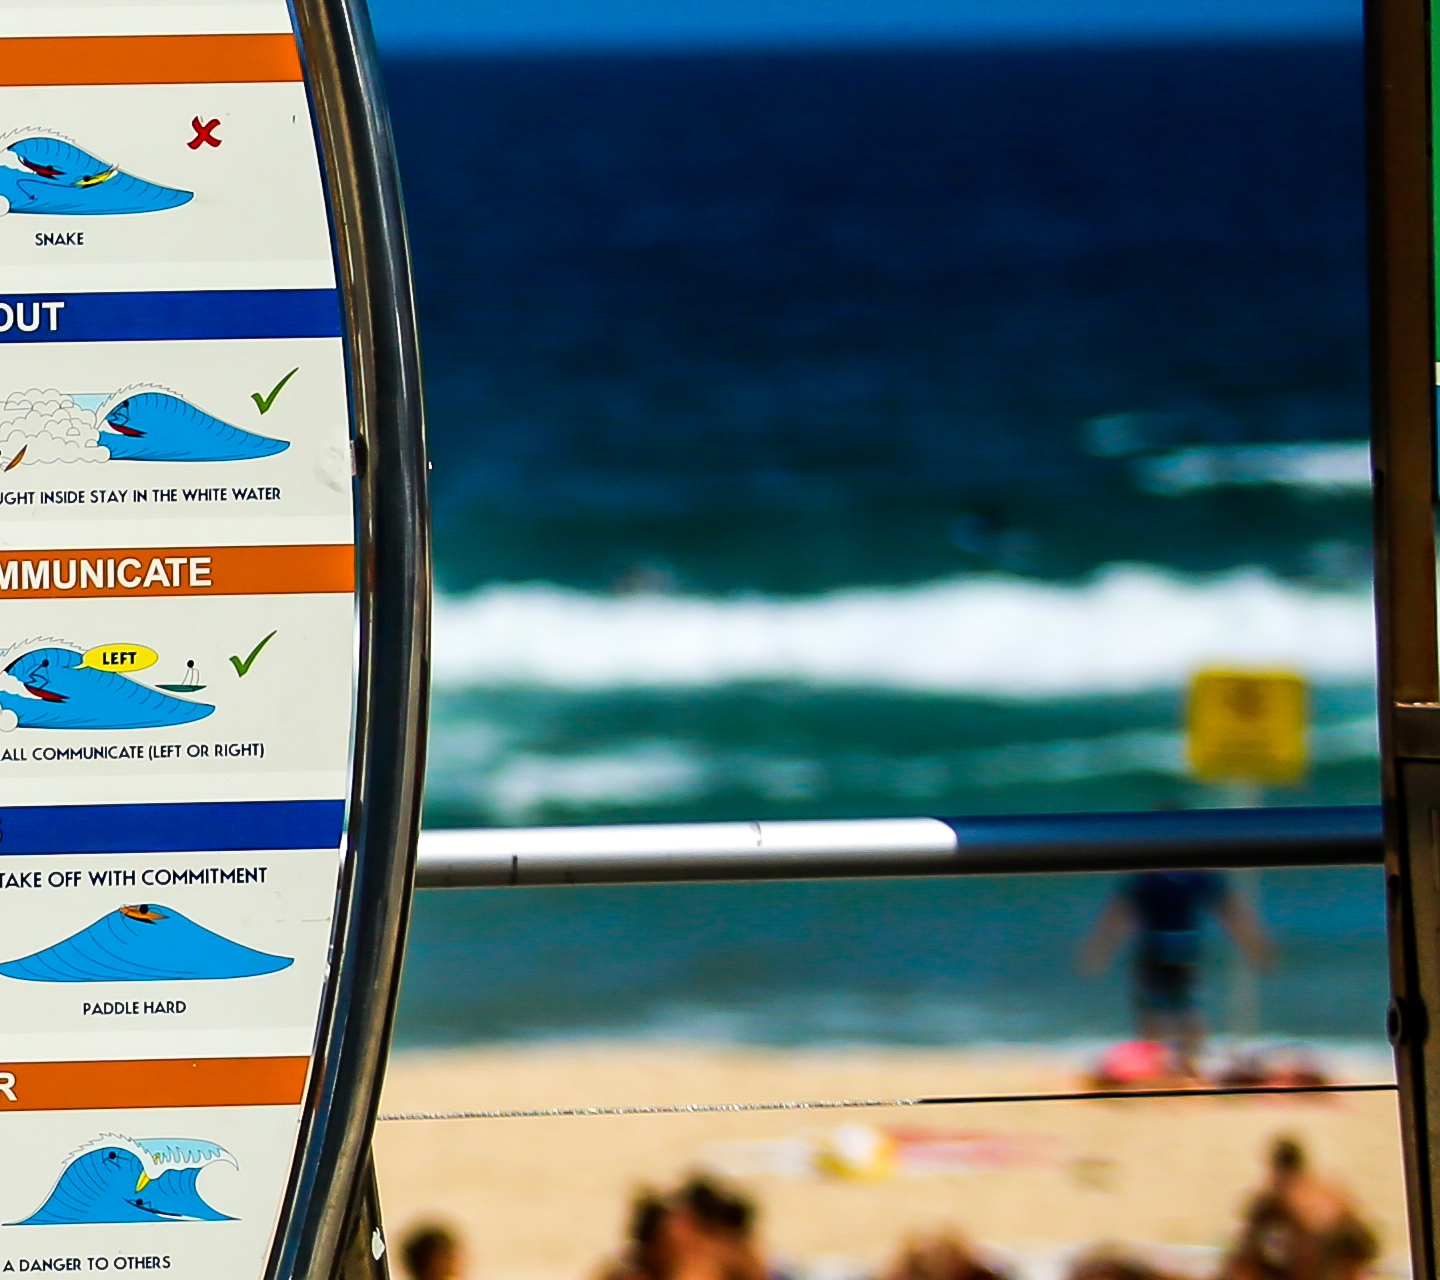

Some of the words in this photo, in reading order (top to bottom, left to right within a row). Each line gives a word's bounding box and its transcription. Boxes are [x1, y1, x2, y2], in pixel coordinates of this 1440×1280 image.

[35, 232, 84, 247] SNAKE
[40, 490, 85, 505] INSIDE
[90, 489, 128, 504] STAY
[133, 489, 148, 503] IN
[151, 488, 178, 503] THE
[181, 487, 228, 502] WHITE
[231, 487, 281, 501] WATER
[102, 651, 137, 666] LEFT
[32, 745, 144, 761] COMMUNICATE
[148, 744, 182, 761] (LEFT
[186, 744, 209, 758] OR
[214, 742, 265, 759] RIGHT)
[47, 870, 82, 888] OFF
[87, 869, 136, 887] WITH
[141, 866, 268, 886] COMMITMENT
[83, 1001, 140, 1016] PADDLE
[143, 1000, 187, 1014] HARD
[2, 1259, 15, 1273] A
[19, 1257, 82, 1272] DANGER
[87, 1256, 109, 1271] TO
[113, 1255, 171, 1270] OTHERS
